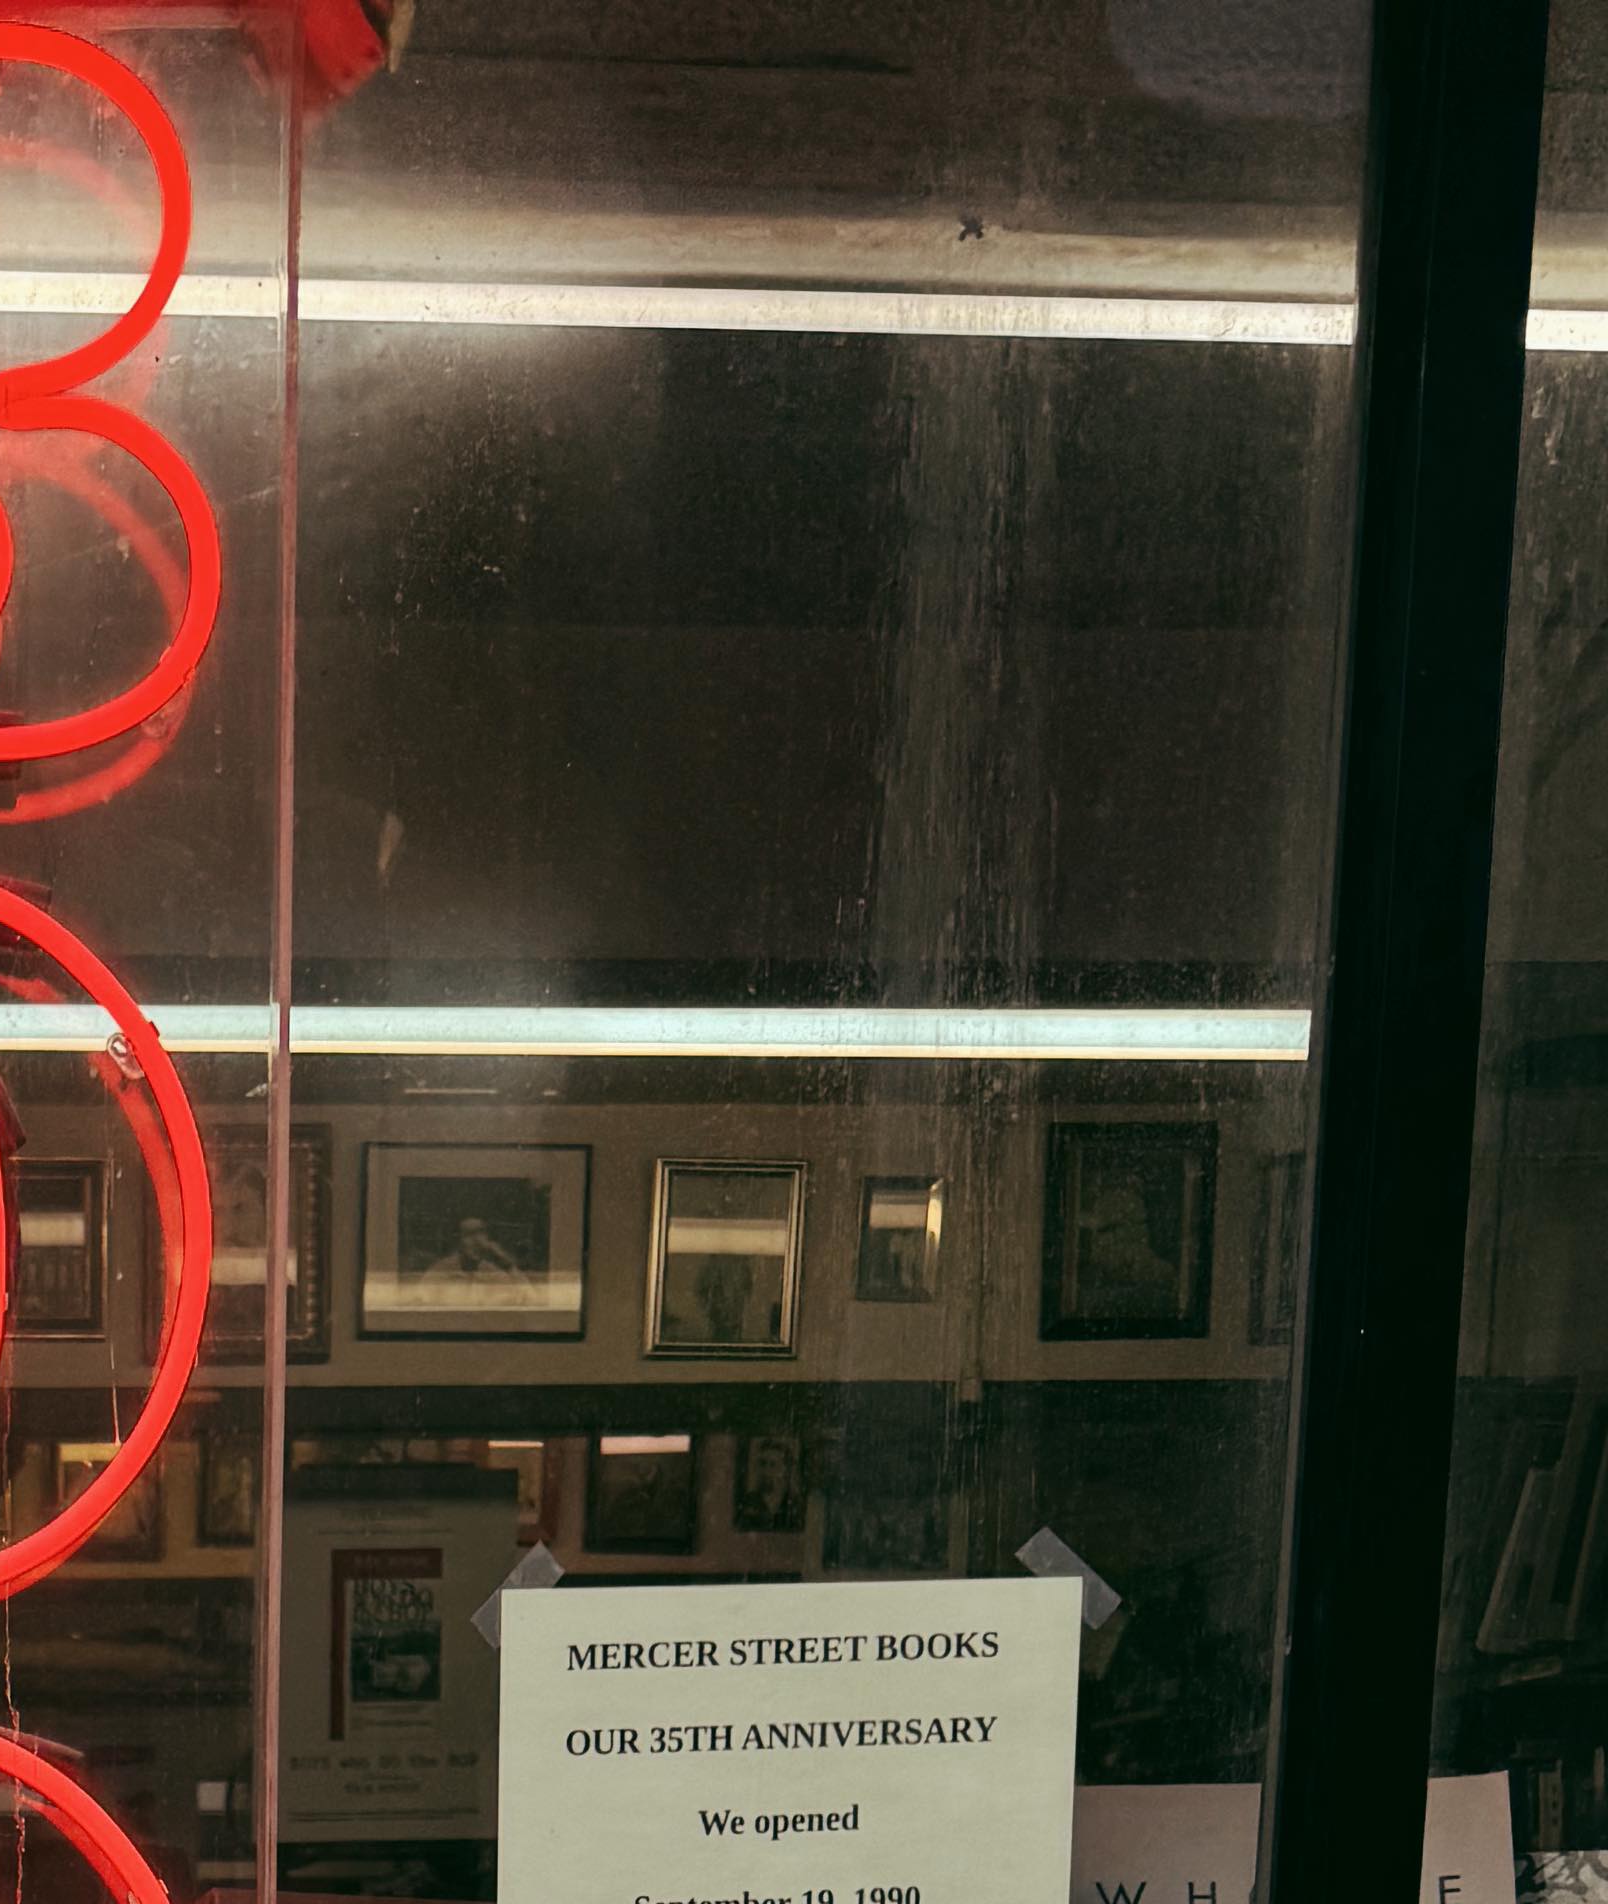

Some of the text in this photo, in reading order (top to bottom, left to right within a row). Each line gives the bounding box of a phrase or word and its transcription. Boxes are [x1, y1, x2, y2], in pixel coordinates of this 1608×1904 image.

[567, 1631, 1000, 1671] MERCER STREET BOOKS
[566, 1716, 998, 1756] OUR 35TH ANNIVERSARY
[698, 1803, 859, 1841] We opened
